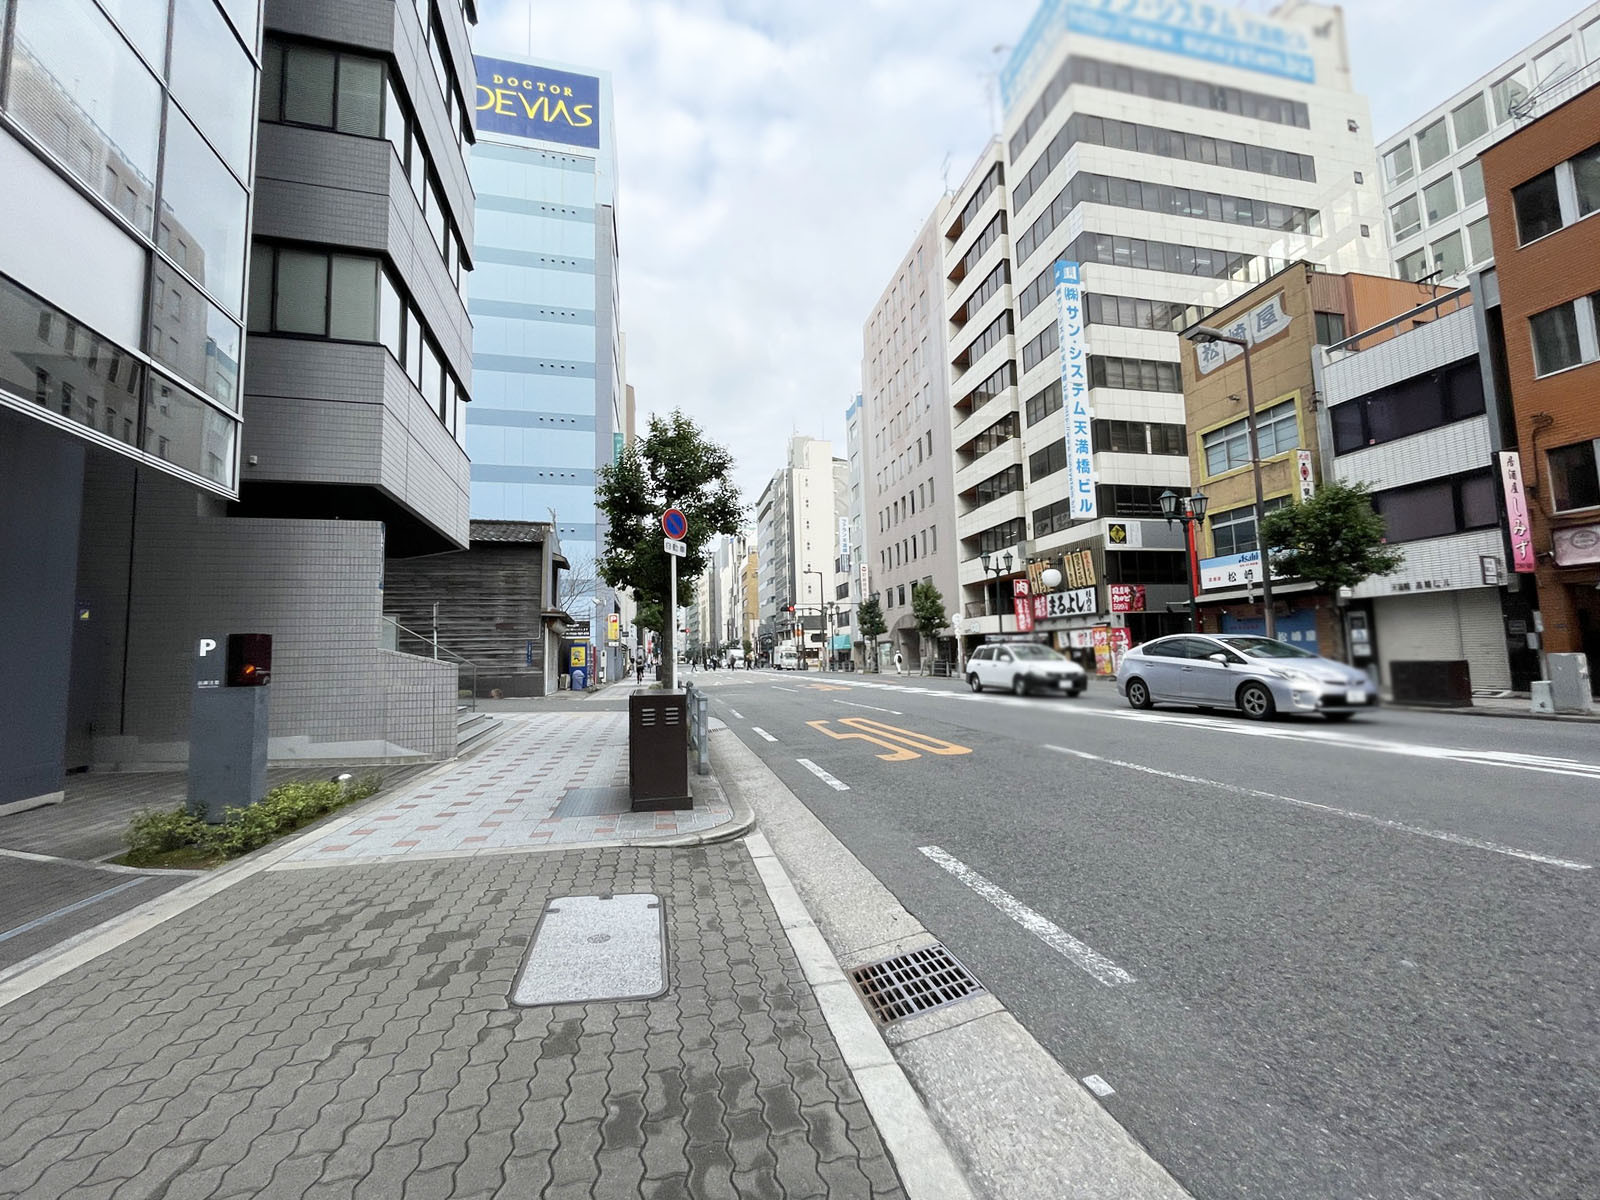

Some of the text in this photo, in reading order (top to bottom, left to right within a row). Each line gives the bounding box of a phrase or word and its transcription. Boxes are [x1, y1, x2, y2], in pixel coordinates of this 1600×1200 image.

[493, 74, 574, 97] DOCTOR
[476, 84, 593, 127] DEVIAS
[1238, 551, 1259, 564] Asahi
[1016, 582, 1029, 597] 肉
[1049, 592, 1085, 615] まるよし
[199, 639, 216, 656] P
